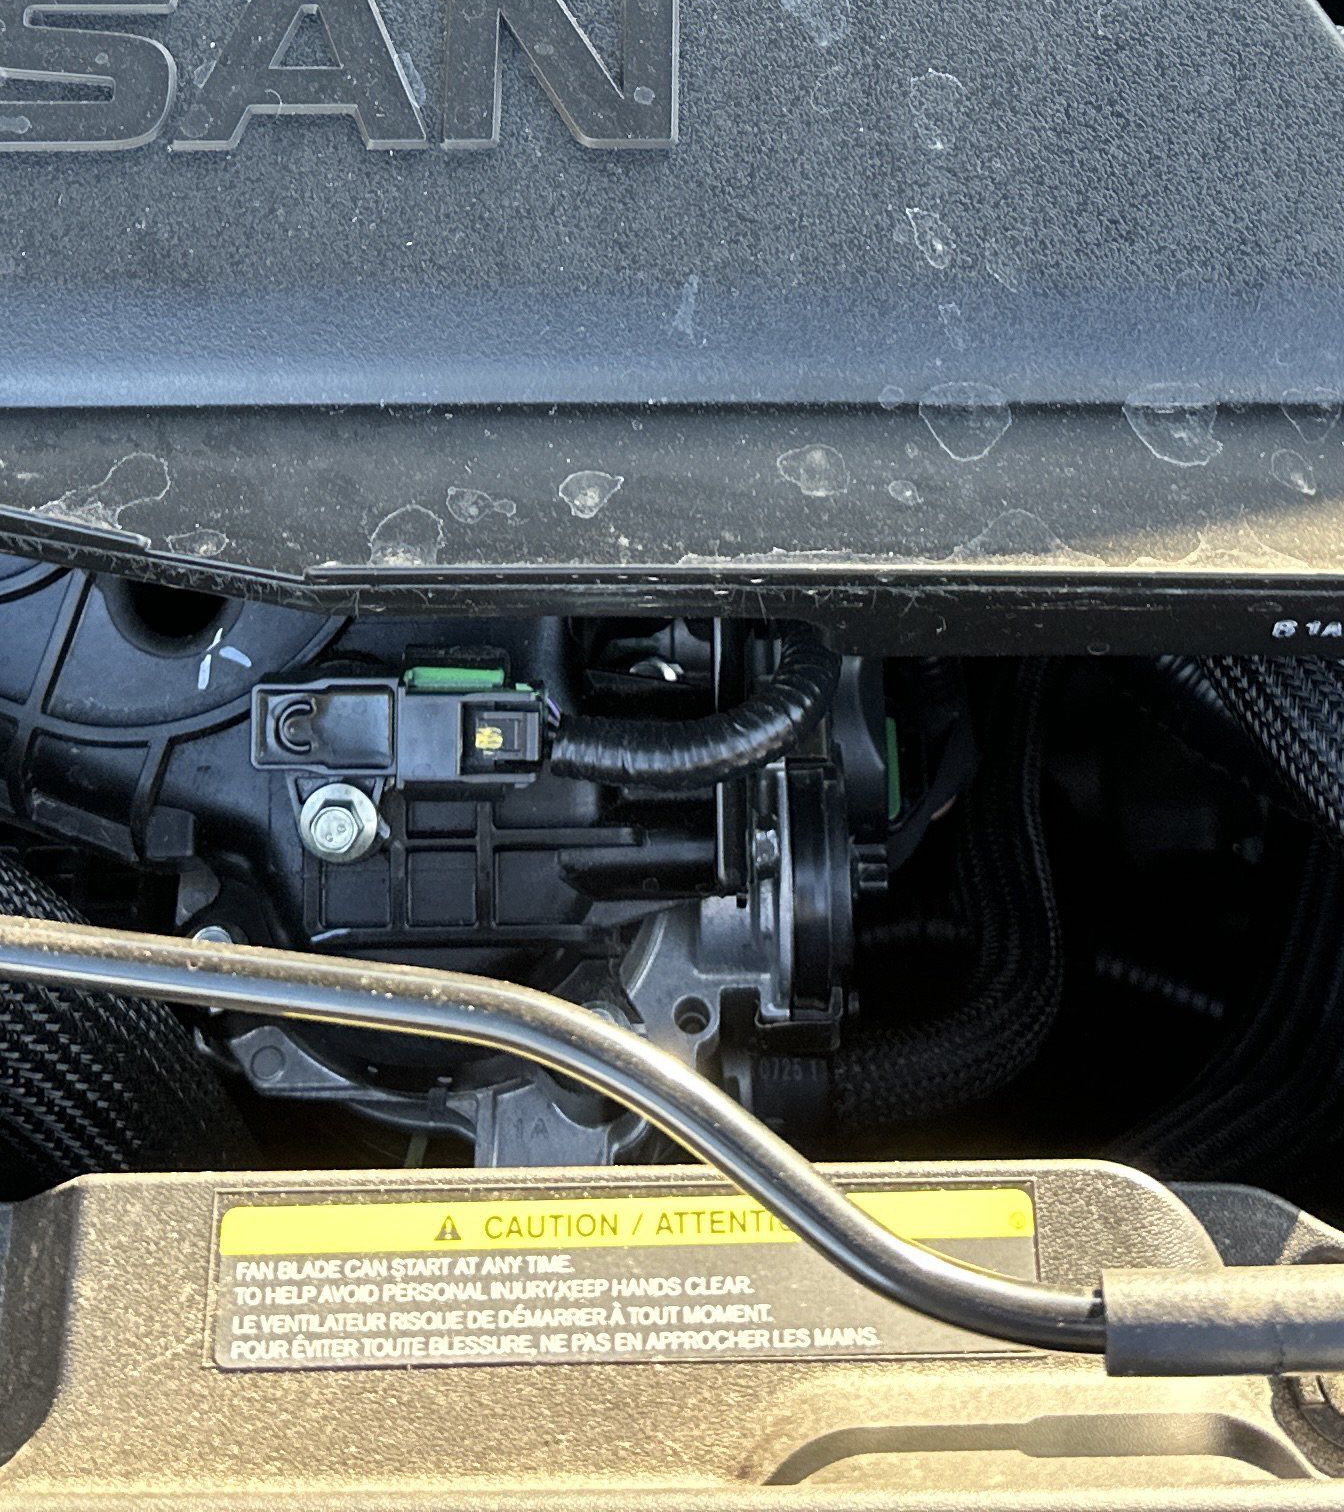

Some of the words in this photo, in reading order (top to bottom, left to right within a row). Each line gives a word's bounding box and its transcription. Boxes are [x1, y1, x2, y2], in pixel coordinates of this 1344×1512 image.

[484, 1213, 618, 1239] CAUTION
[656, 1210, 791, 1234] ATTENTI
[235, 1261, 274, 1281] FAN
[277, 1259, 342, 1280] BLADE
[344, 1259, 388, 1278] CAN
[390, 1257, 452, 1278] START
[454, 1256, 479, 1275] AT
[481, 1256, 523, 1275] ANY
[525, 1254, 575, 1274] TIME.
[234, 1286, 262, 1306] TO
[265, 1286, 317, 1306] HELP
[318, 1284, 379, 1304] AVOID
[382, 1282, 488, 1303] PERSONAL
[611, 1276, 682, 1298] HANDS
[685, 1275, 755, 1296] CLEAR.
[232, 1315, 257, 1335] LE
[260, 1312, 387, 1334] VENTILATEUR
[389, 1310, 464, 1331] RISQUE
[467, 1310, 496, 1330] DE
[498, 1303, 607, 1329] DÉMARRER
[627, 1305, 680, 1326] TOUT
[683, 1303, 775, 1324] MOMENT.
[230, 1340, 290, 1361] POUR
[361, 1337, 426, 1358] TOUTE
[428, 1335, 538, 1357] BLESSURE,
[540, 1333, 570, 1354] NE
[571, 1332, 612, 1354] PAS
[614, 1332, 643, 1352] EN
[645, 1328, 770, 1352] APPROCHER
[772, 1327, 811, 1349] LES
[814, 1326, 882, 1348] MAINS.
